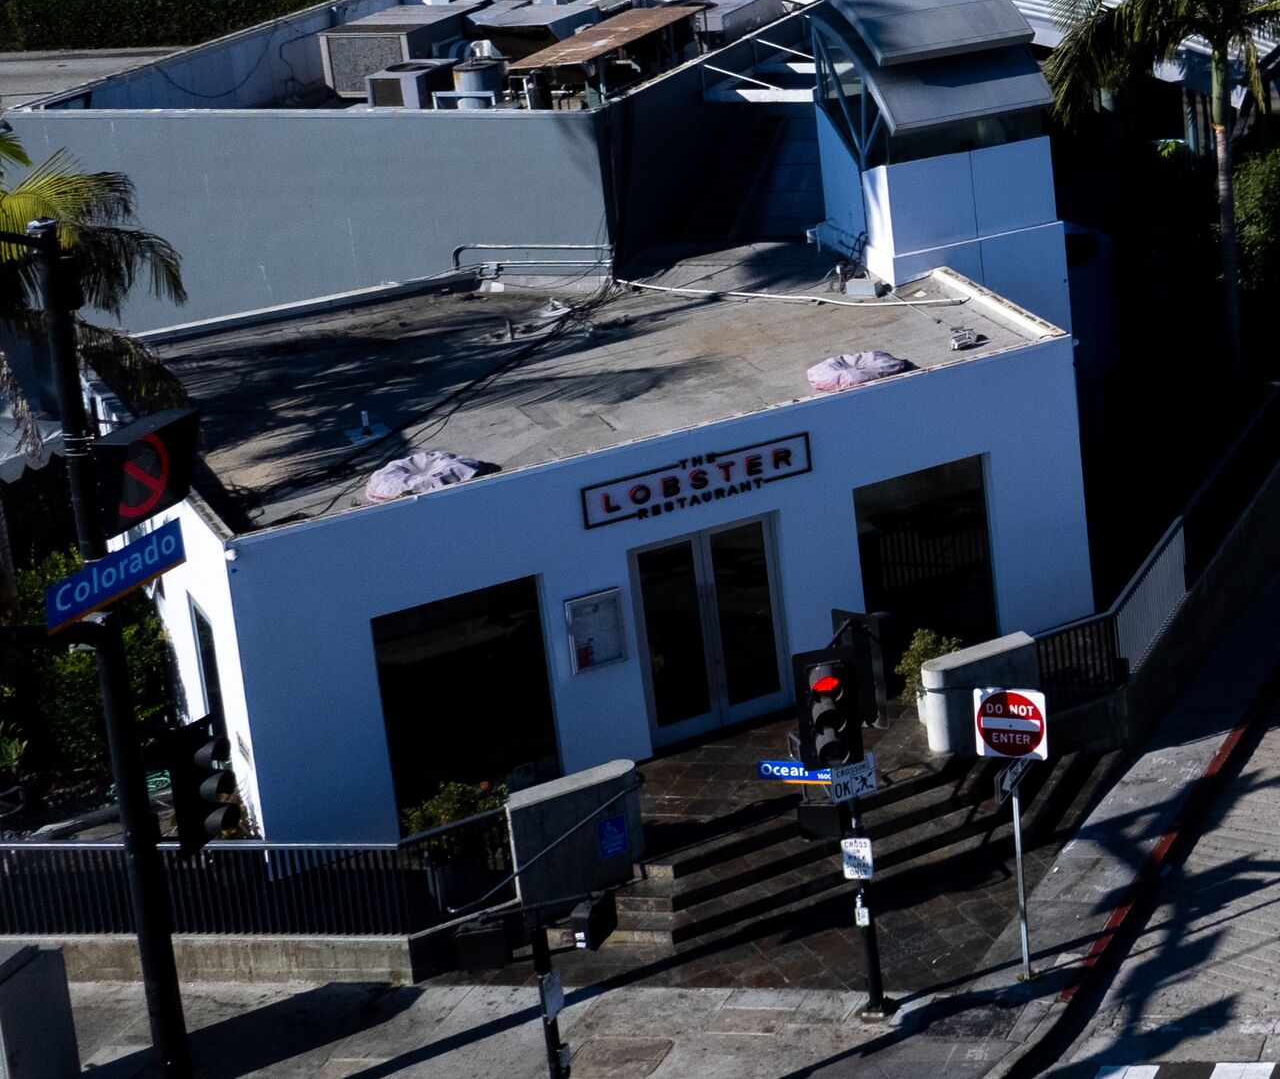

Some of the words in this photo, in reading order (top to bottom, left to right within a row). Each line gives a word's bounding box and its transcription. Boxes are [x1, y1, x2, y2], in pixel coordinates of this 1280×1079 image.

[679, 452, 718, 471] THE
[602, 447, 793, 514] LOBSTER
[636, 478, 764, 520] RESTAURANT
[55, 534, 176, 612] Colorado
[986, 703, 1004, 714] DO
[1009, 704, 1035, 717] NOT
[992, 732, 1031, 744] ENTER
[835, 780, 851, 799] OK
